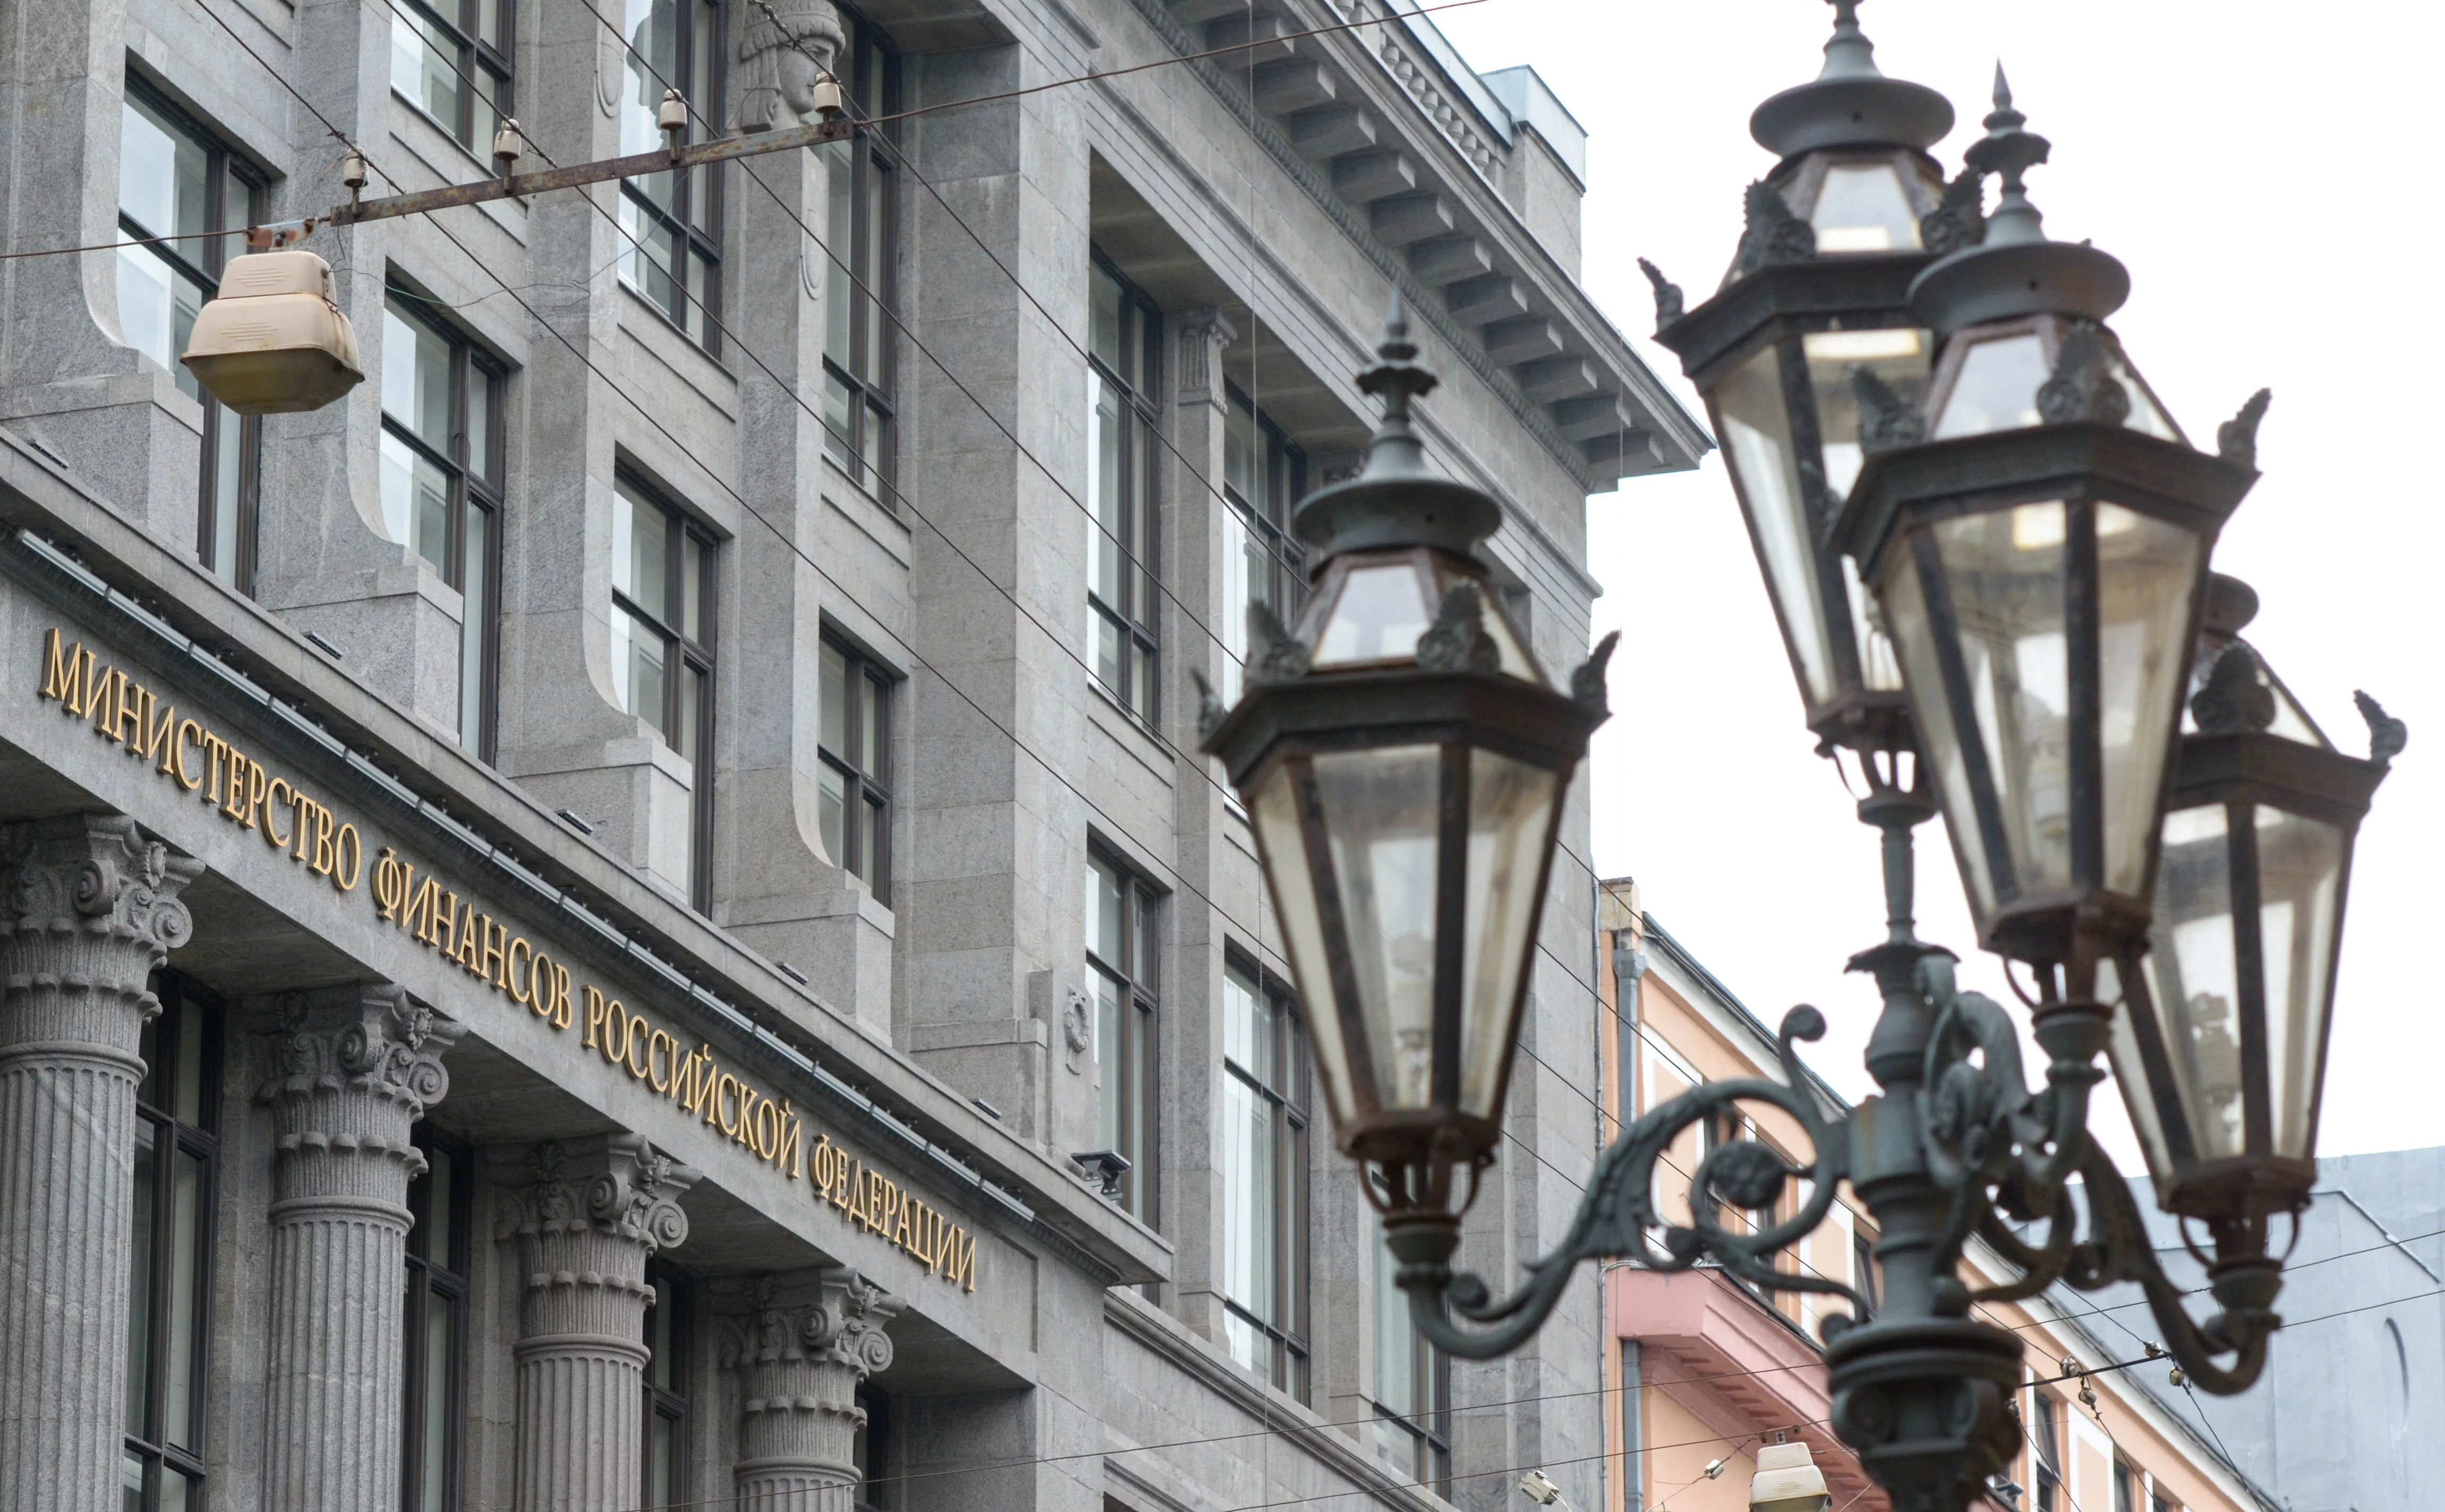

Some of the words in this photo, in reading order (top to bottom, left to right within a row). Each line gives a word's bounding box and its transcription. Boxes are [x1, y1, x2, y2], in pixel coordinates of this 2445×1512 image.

[40, 628, 361, 891] МИНИСТЕРСТВО
[372, 846, 572, 1030] ФИНАНСОВ
[582, 984, 800, 1179] РОССИЙСКОЙ
[809, 1133, 976, 1293] ФЕДЕРАЦИИ
